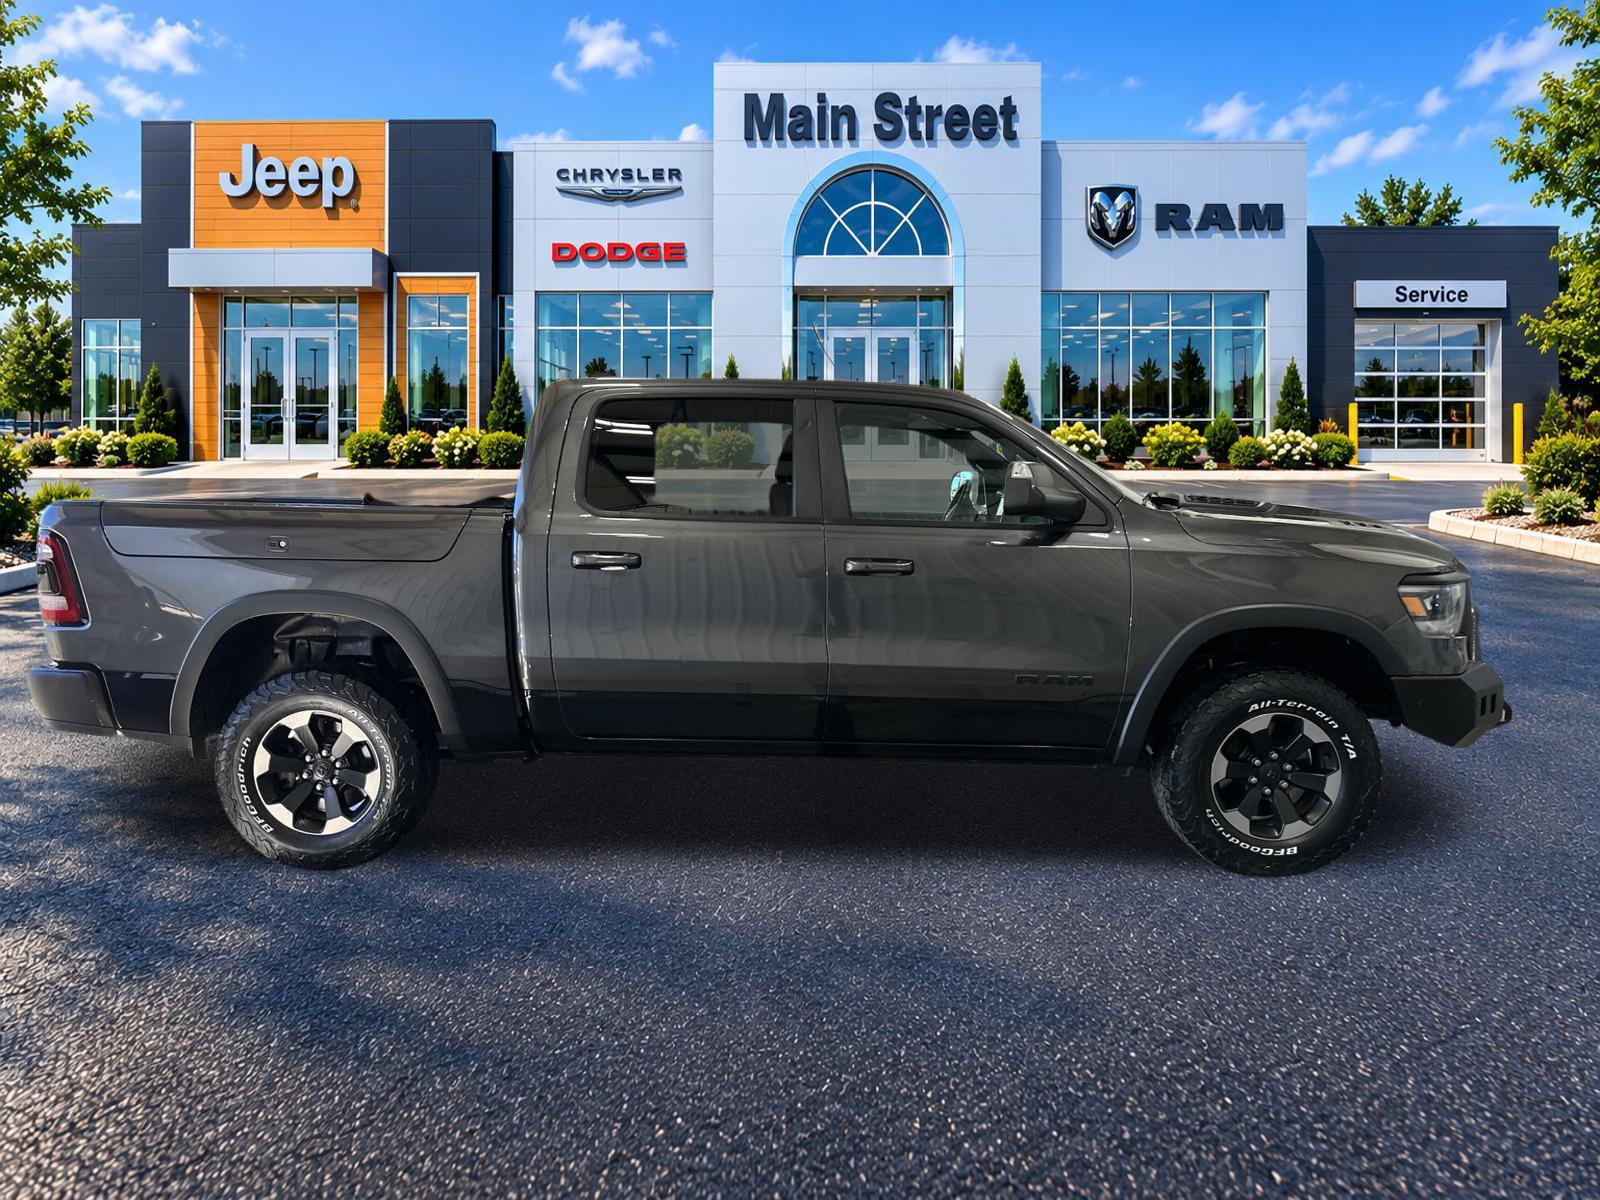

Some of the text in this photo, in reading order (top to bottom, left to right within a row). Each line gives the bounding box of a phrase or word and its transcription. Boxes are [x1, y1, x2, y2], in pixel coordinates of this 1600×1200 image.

[744, 91, 1018, 141] Main Street
[219, 143, 354, 208] Jeep
[556, 168, 683, 183] CHRYSLER
[1155, 203, 1284, 231] RAM
[551, 242, 686, 262] DODGE
[1395, 285, 1469, 303] Service
[1248, 699, 1357, 759] All-Terrain T/A
[236, 737, 274, 834] BFGoodrich
[1206, 808, 1298, 856] BFGoodrich
